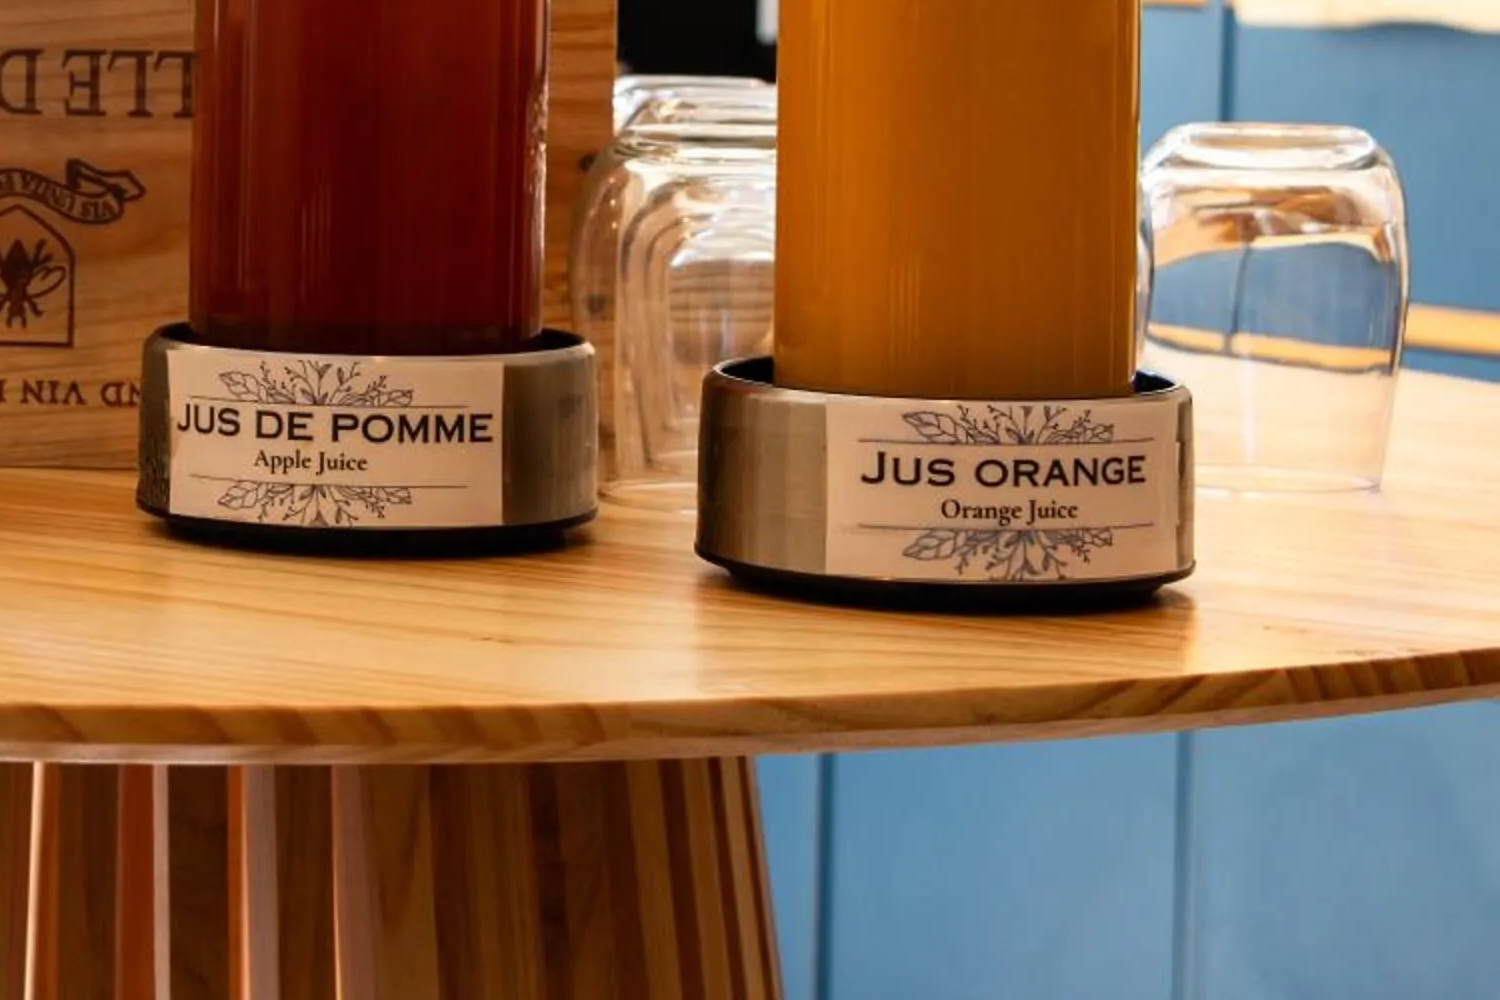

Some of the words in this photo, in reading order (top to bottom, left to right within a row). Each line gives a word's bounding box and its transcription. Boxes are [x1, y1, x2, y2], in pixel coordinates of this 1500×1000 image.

[20, 378, 87, 405] VIN
[177, 403, 241, 437] JUS
[255, 409, 314, 441] DE
[331, 412, 494, 444] POMME
[254, 449, 312, 475] Apple
[316, 451, 368, 475] Juice
[974, 454, 1146, 488] ORANGE
[941, 499, 1022, 526] Orange
[1026, 500, 1078, 526] Juice
